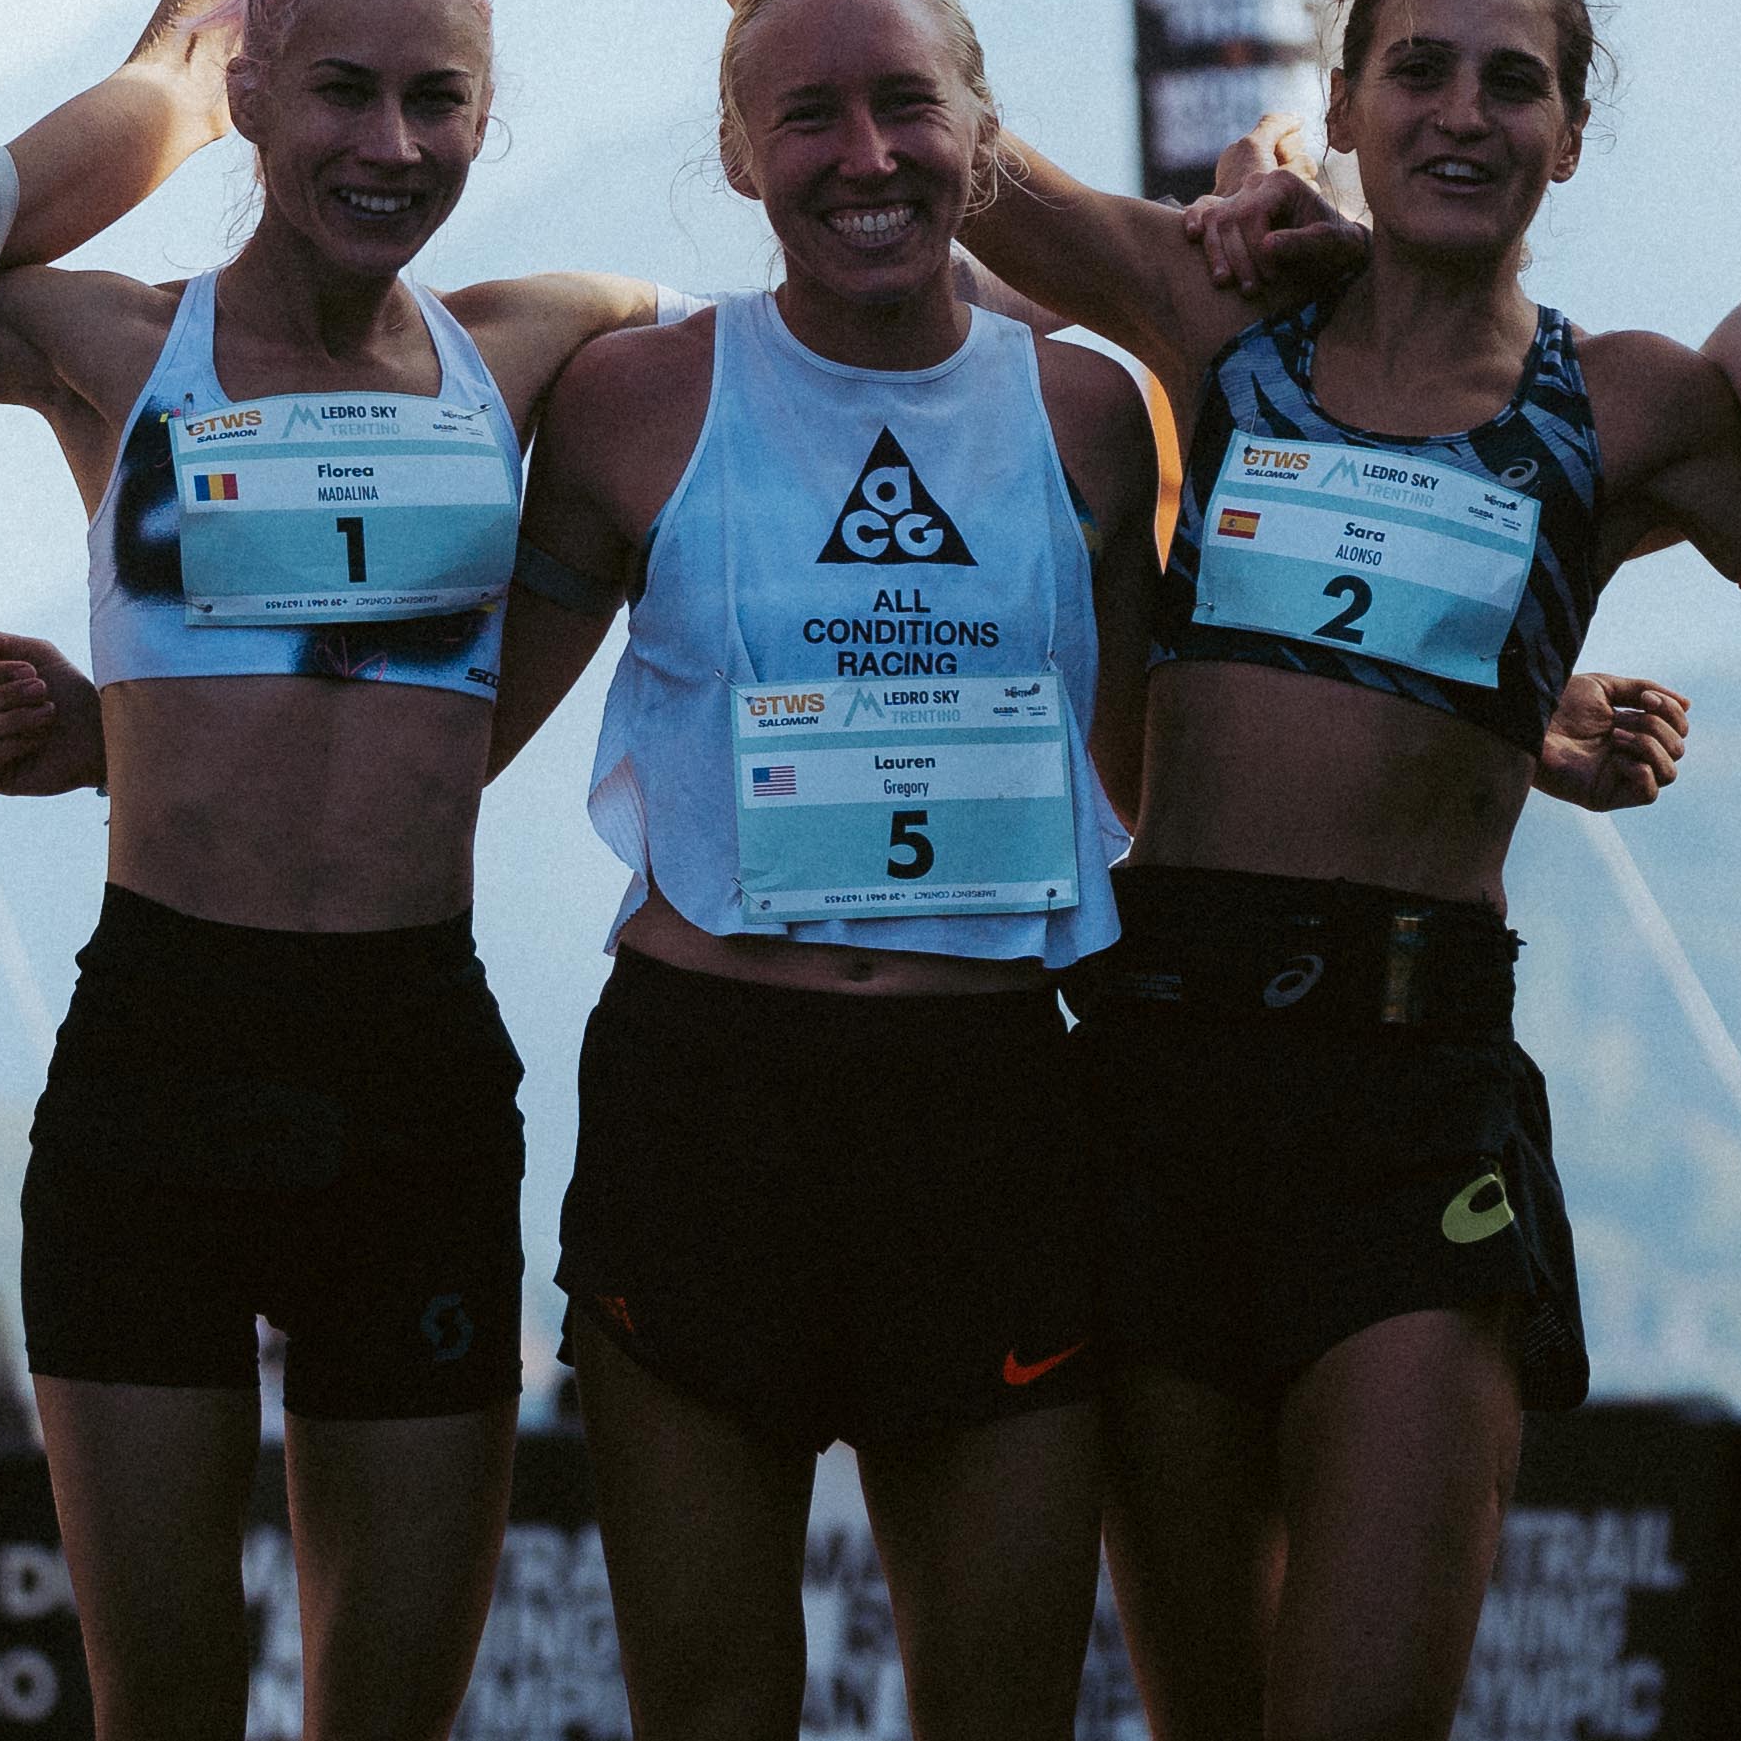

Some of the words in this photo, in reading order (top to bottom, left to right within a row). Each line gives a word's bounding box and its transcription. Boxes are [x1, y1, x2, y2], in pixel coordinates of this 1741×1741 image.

[187, 409, 263, 437] GTWS
[321, 405, 367, 419] LEDRO
[371, 405, 398, 419] SKY
[196, 428, 258, 443] SALOMON
[329, 422, 400, 436] TRENTINO
[317, 463, 375, 478] Florea
[1242, 447, 1311, 471] GTWS
[1244, 468, 1299, 481] SALOMON
[1362, 463, 1409, 485] LEDRO
[1410, 473, 1440, 492] SKY
[317, 485, 380, 502] MADALINA
[1365, 482, 1434, 509] TRENTINO
[1343, 521, 1386, 543] Sara
[336, 516, 368, 584] 1
[1335, 543, 1383, 567] ALONSO
[873, 588, 931, 614] ALL
[1312, 574, 1373, 646] 2
[803, 617, 1000, 648] CONDITIONS
[837, 650, 958, 677] RACING
[749, 692, 826, 716] GTWS
[883, 690, 929, 706] LEDRO
[932, 689, 960, 705] SKY
[758, 715, 819, 728] SALOMON
[892, 708, 961, 725] TRENTINO
[874, 754, 936, 771] Lauren
[883, 778, 929, 798] Gregory
[886, 809, 936, 880] 5
